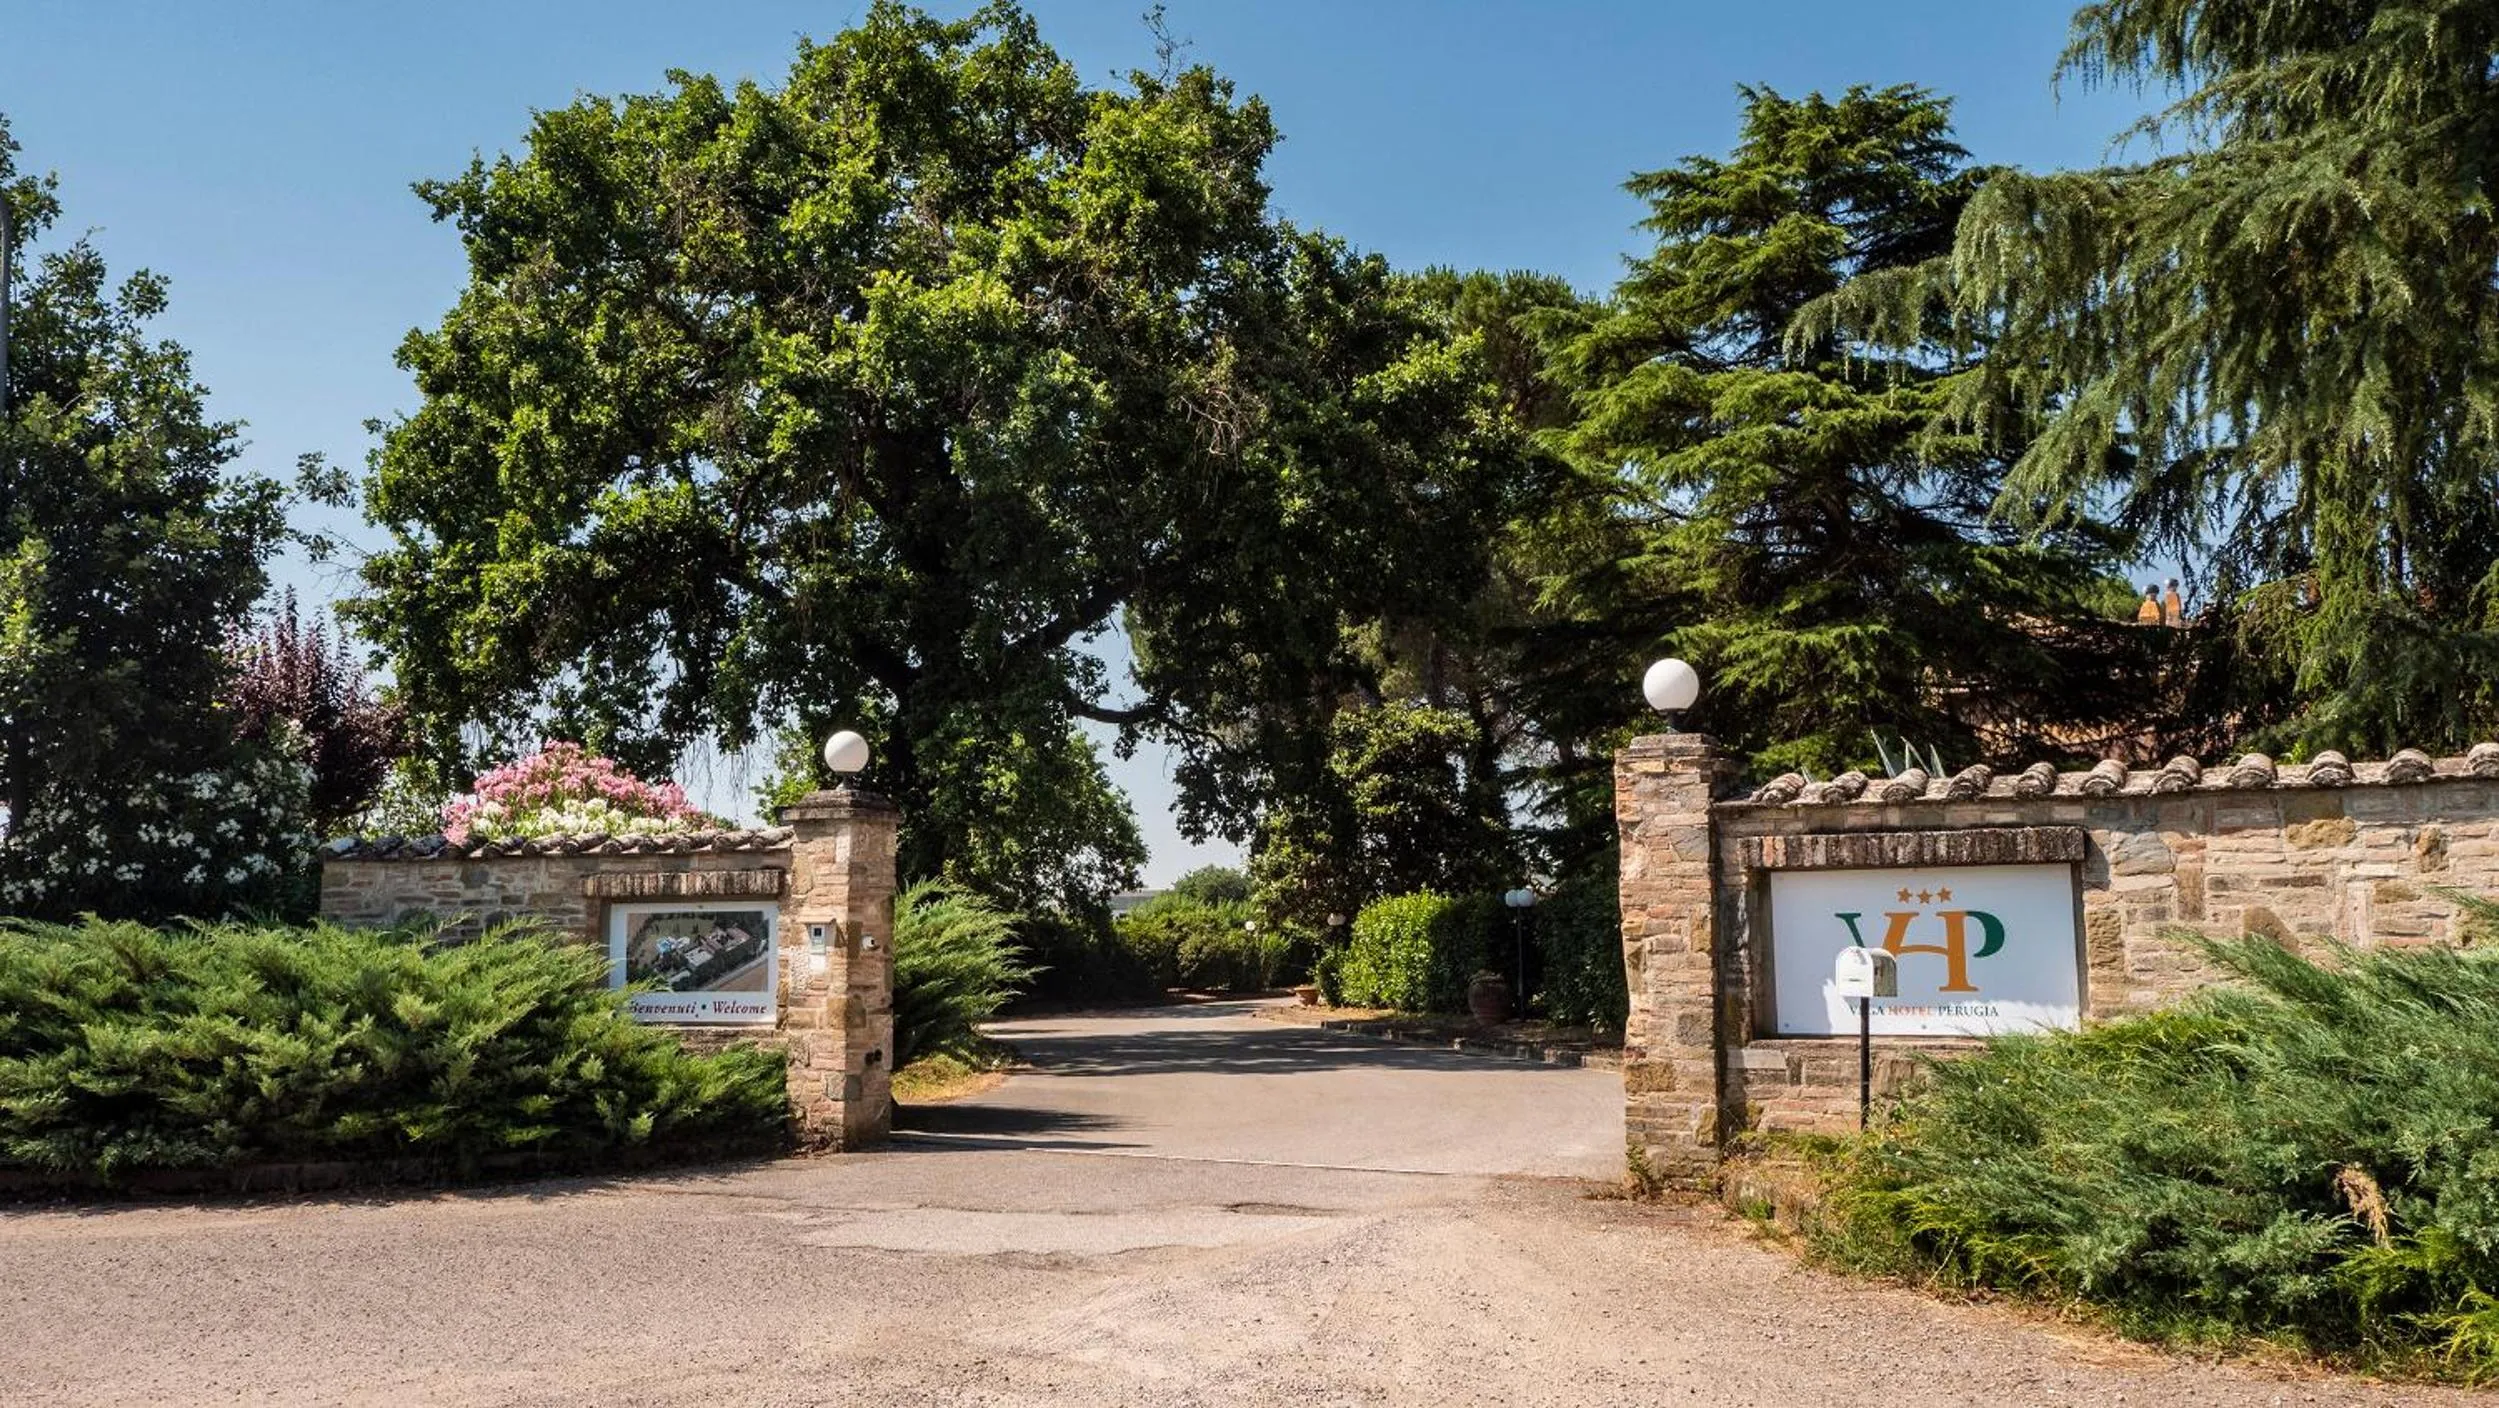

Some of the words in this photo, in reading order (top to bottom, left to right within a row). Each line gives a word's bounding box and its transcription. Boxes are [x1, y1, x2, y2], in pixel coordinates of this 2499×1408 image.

[712, 1001, 767, 1014] Welcome
[1849, 1005, 1885, 1017] VGA
[1888, 1005, 1933, 1017] HOTEL
[1938, 1005, 1999, 1017] PERUGIA
